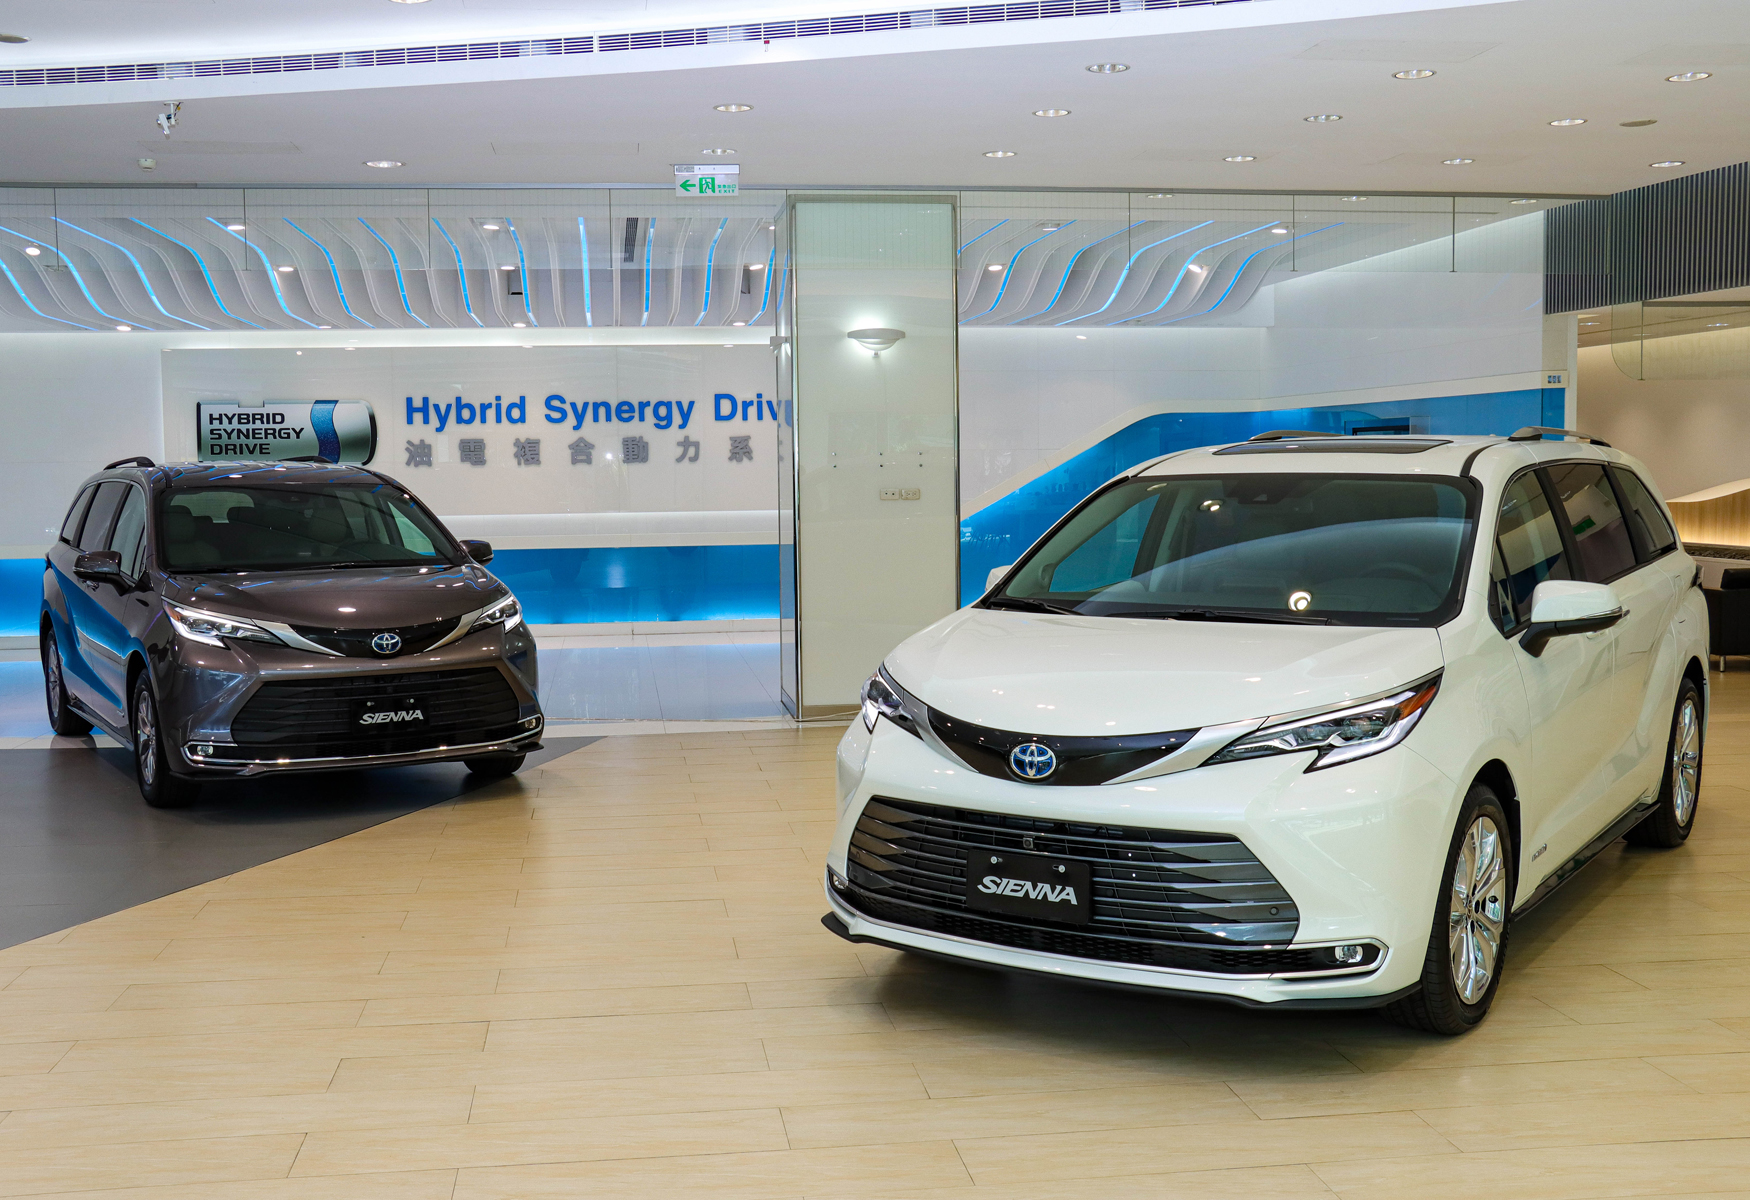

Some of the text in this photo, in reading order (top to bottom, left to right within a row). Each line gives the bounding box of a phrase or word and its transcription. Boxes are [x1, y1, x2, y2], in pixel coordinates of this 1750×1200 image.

[209, 412, 285, 425] HYBRID
[405, 393, 792, 432] Hybrid Synergy Driv
[210, 427, 304, 441] SYNERGY
[210, 443, 271, 456] DRIVE
[359, 709, 424, 725] SIENNA
[977, 875, 1078, 906] SIENNA
